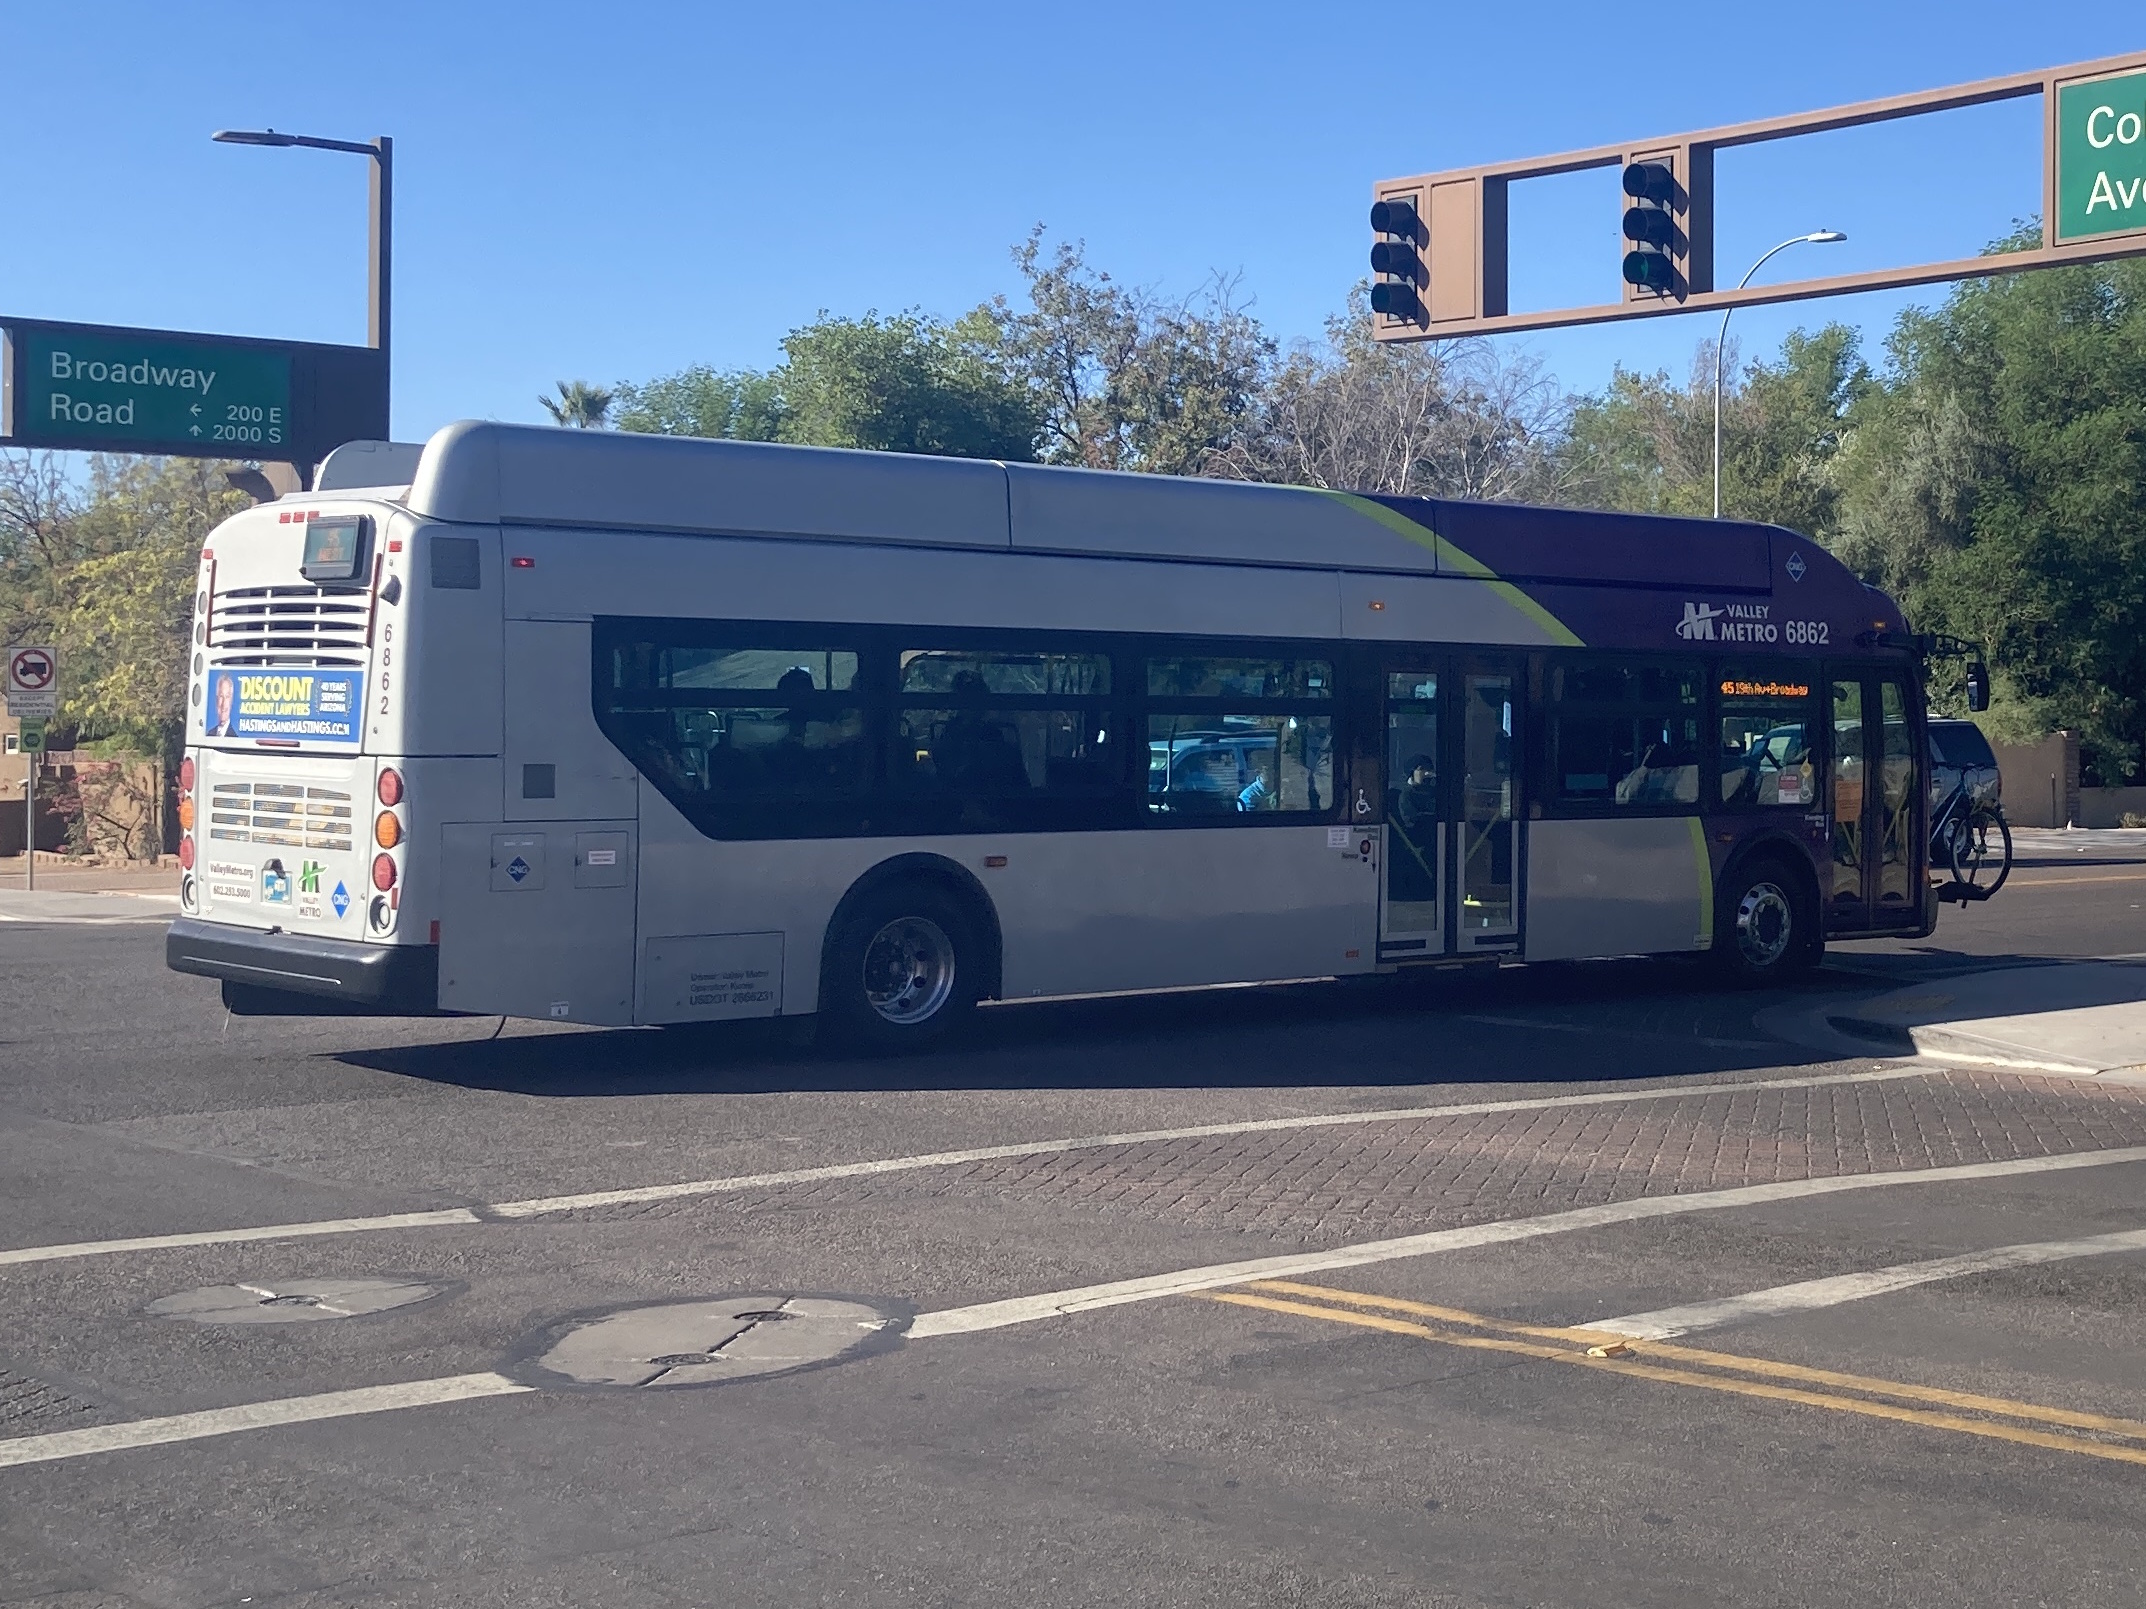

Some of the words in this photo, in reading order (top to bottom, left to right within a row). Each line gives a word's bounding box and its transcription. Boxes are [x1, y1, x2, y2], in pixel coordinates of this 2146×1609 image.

[2085, 171, 2146, 215] Av
[51, 351, 216, 396] Broadway
[51, 393, 134, 425] Road
[226, 405, 263, 423] 200
[269, 407, 282, 424] E
[212, 424, 262, 443] 2000
[268, 427, 282, 444] S
[1726, 604, 1770, 619] VALLEY
[1721, 622, 1778, 643] METRO
[1785, 620, 1830, 645] 6862
[380, 623, 393, 715] 6862
[240, 676, 314, 702] DISCOUNT
[1721, 681, 1734, 695] 45
[240, 702, 275, 715] ACCIDENT
[275, 703, 310, 716] LAWYERS
[507, 864, 530, 875] CNG
[333, 893, 349, 906] CNG
[299, 906, 322, 918] METRO
